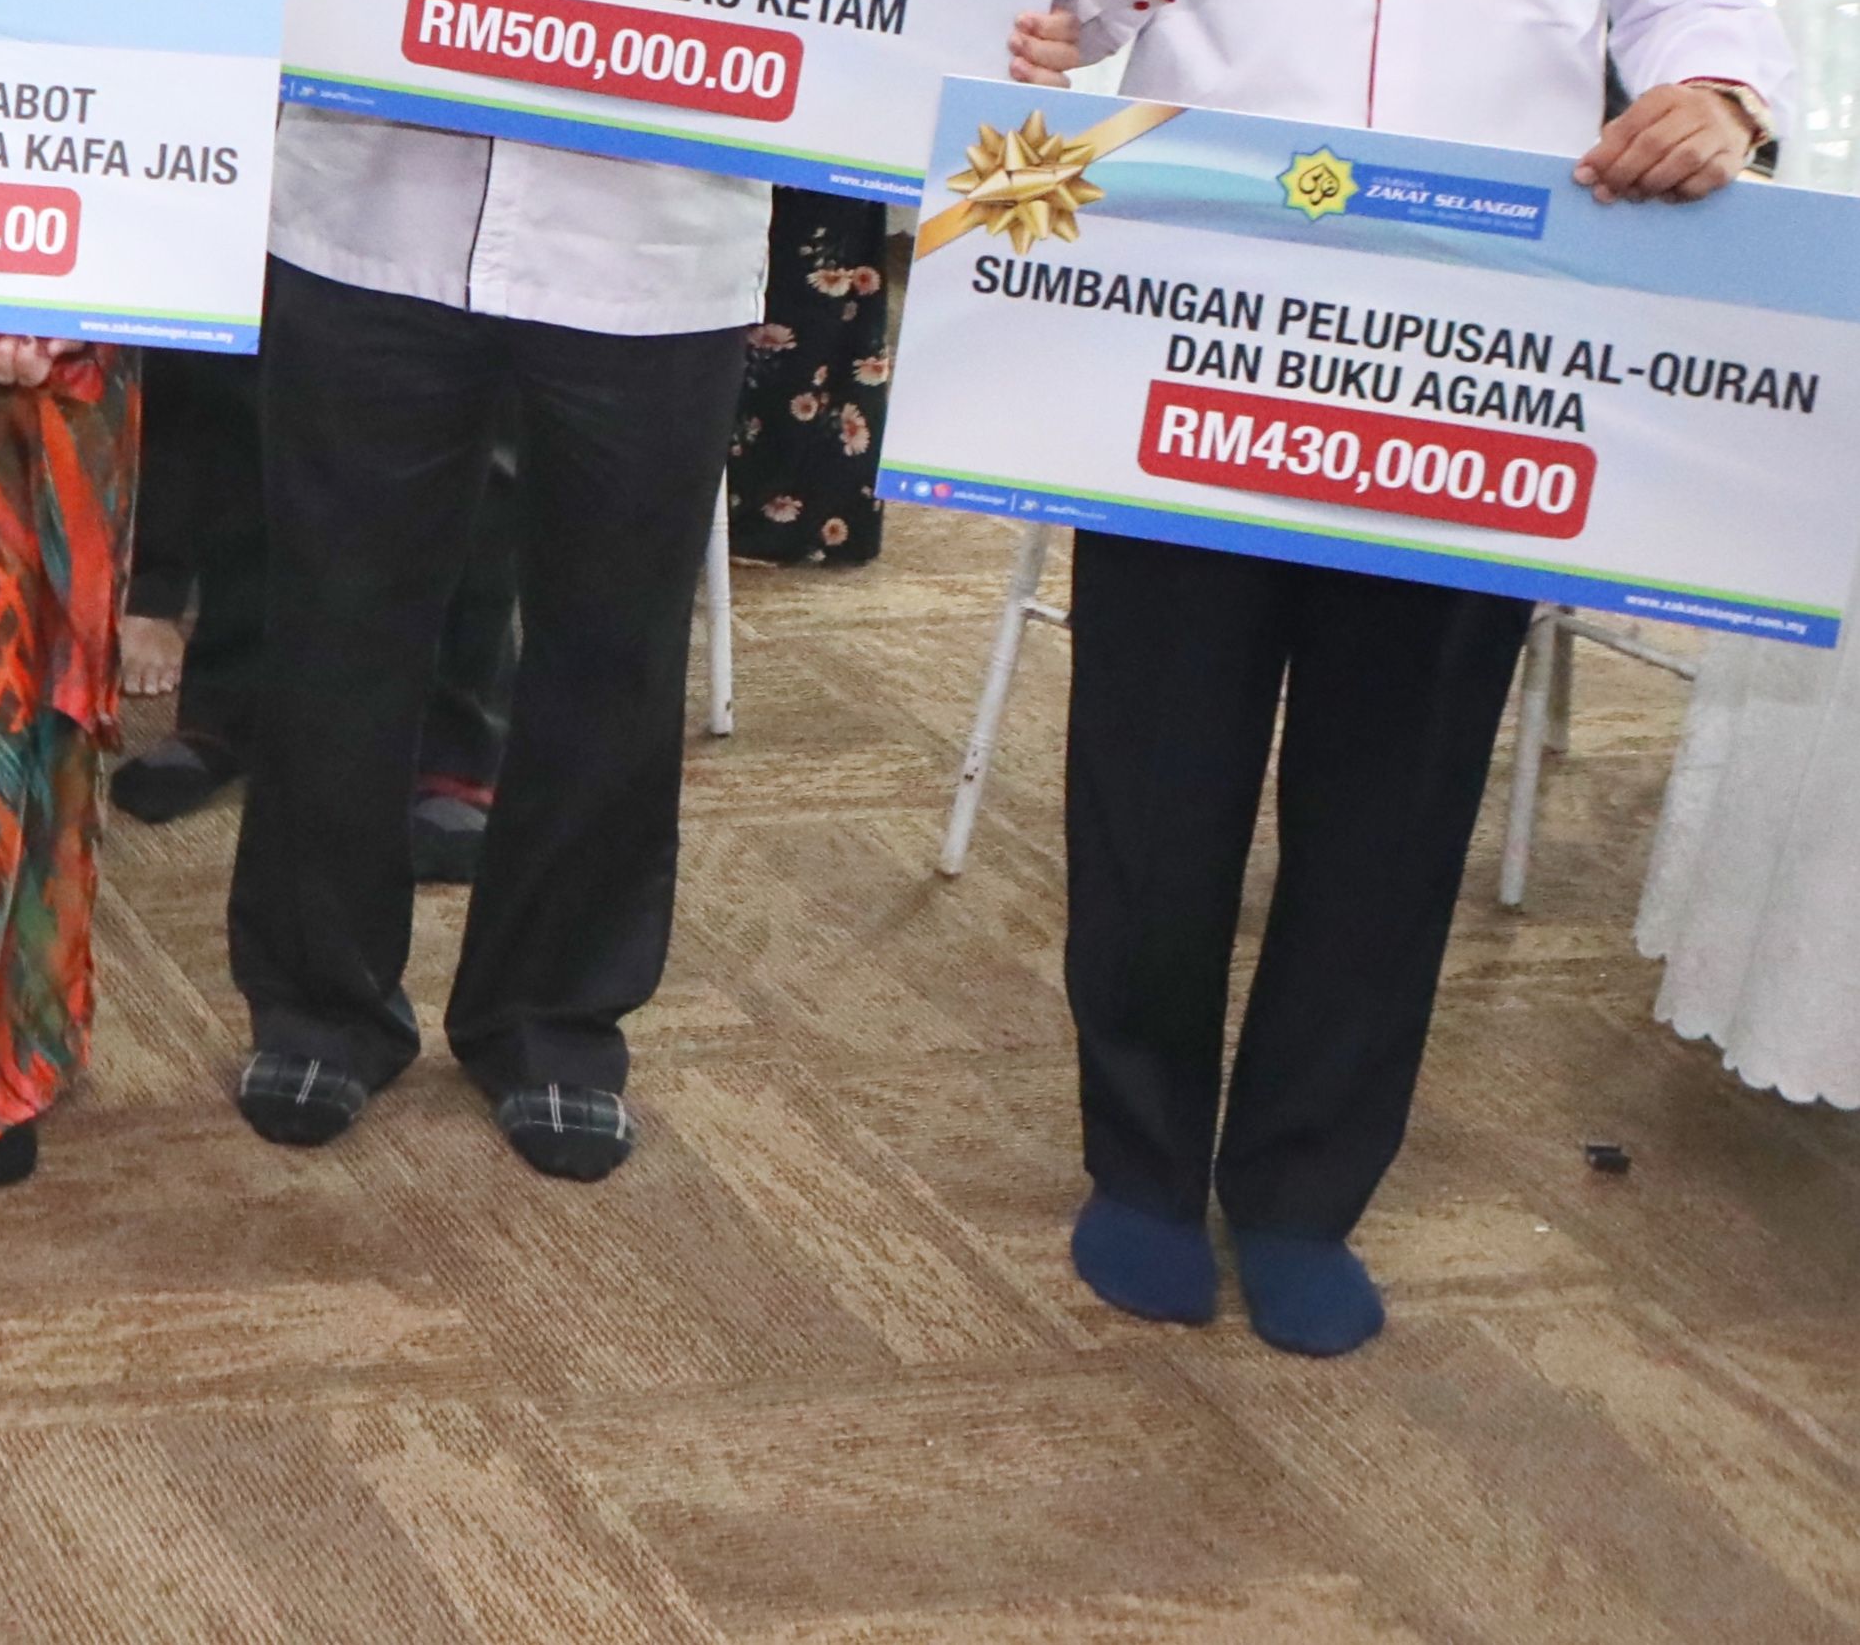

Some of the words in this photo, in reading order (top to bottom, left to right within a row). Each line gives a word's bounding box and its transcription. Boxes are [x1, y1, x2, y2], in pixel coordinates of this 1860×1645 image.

[28, 136, 126, 173] KAFA
[146, 145, 236, 183] JAIS
[1366, 184, 1431, 204] ZAKAT
[1434, 193, 1539, 220] SELANGOR
[973, 256, 1263, 331] SUMBANGAN
[1278, 298, 1552, 372] PELUPUSAN
[1563, 341, 1818, 413] AL-QURAN
[1167, 335, 1262, 383] DAN
[1277, 351, 1401, 403] BUKU
[1412, 371, 1584, 432] AGAMA
[1158, 405, 1576, 513] RM430,000.00
